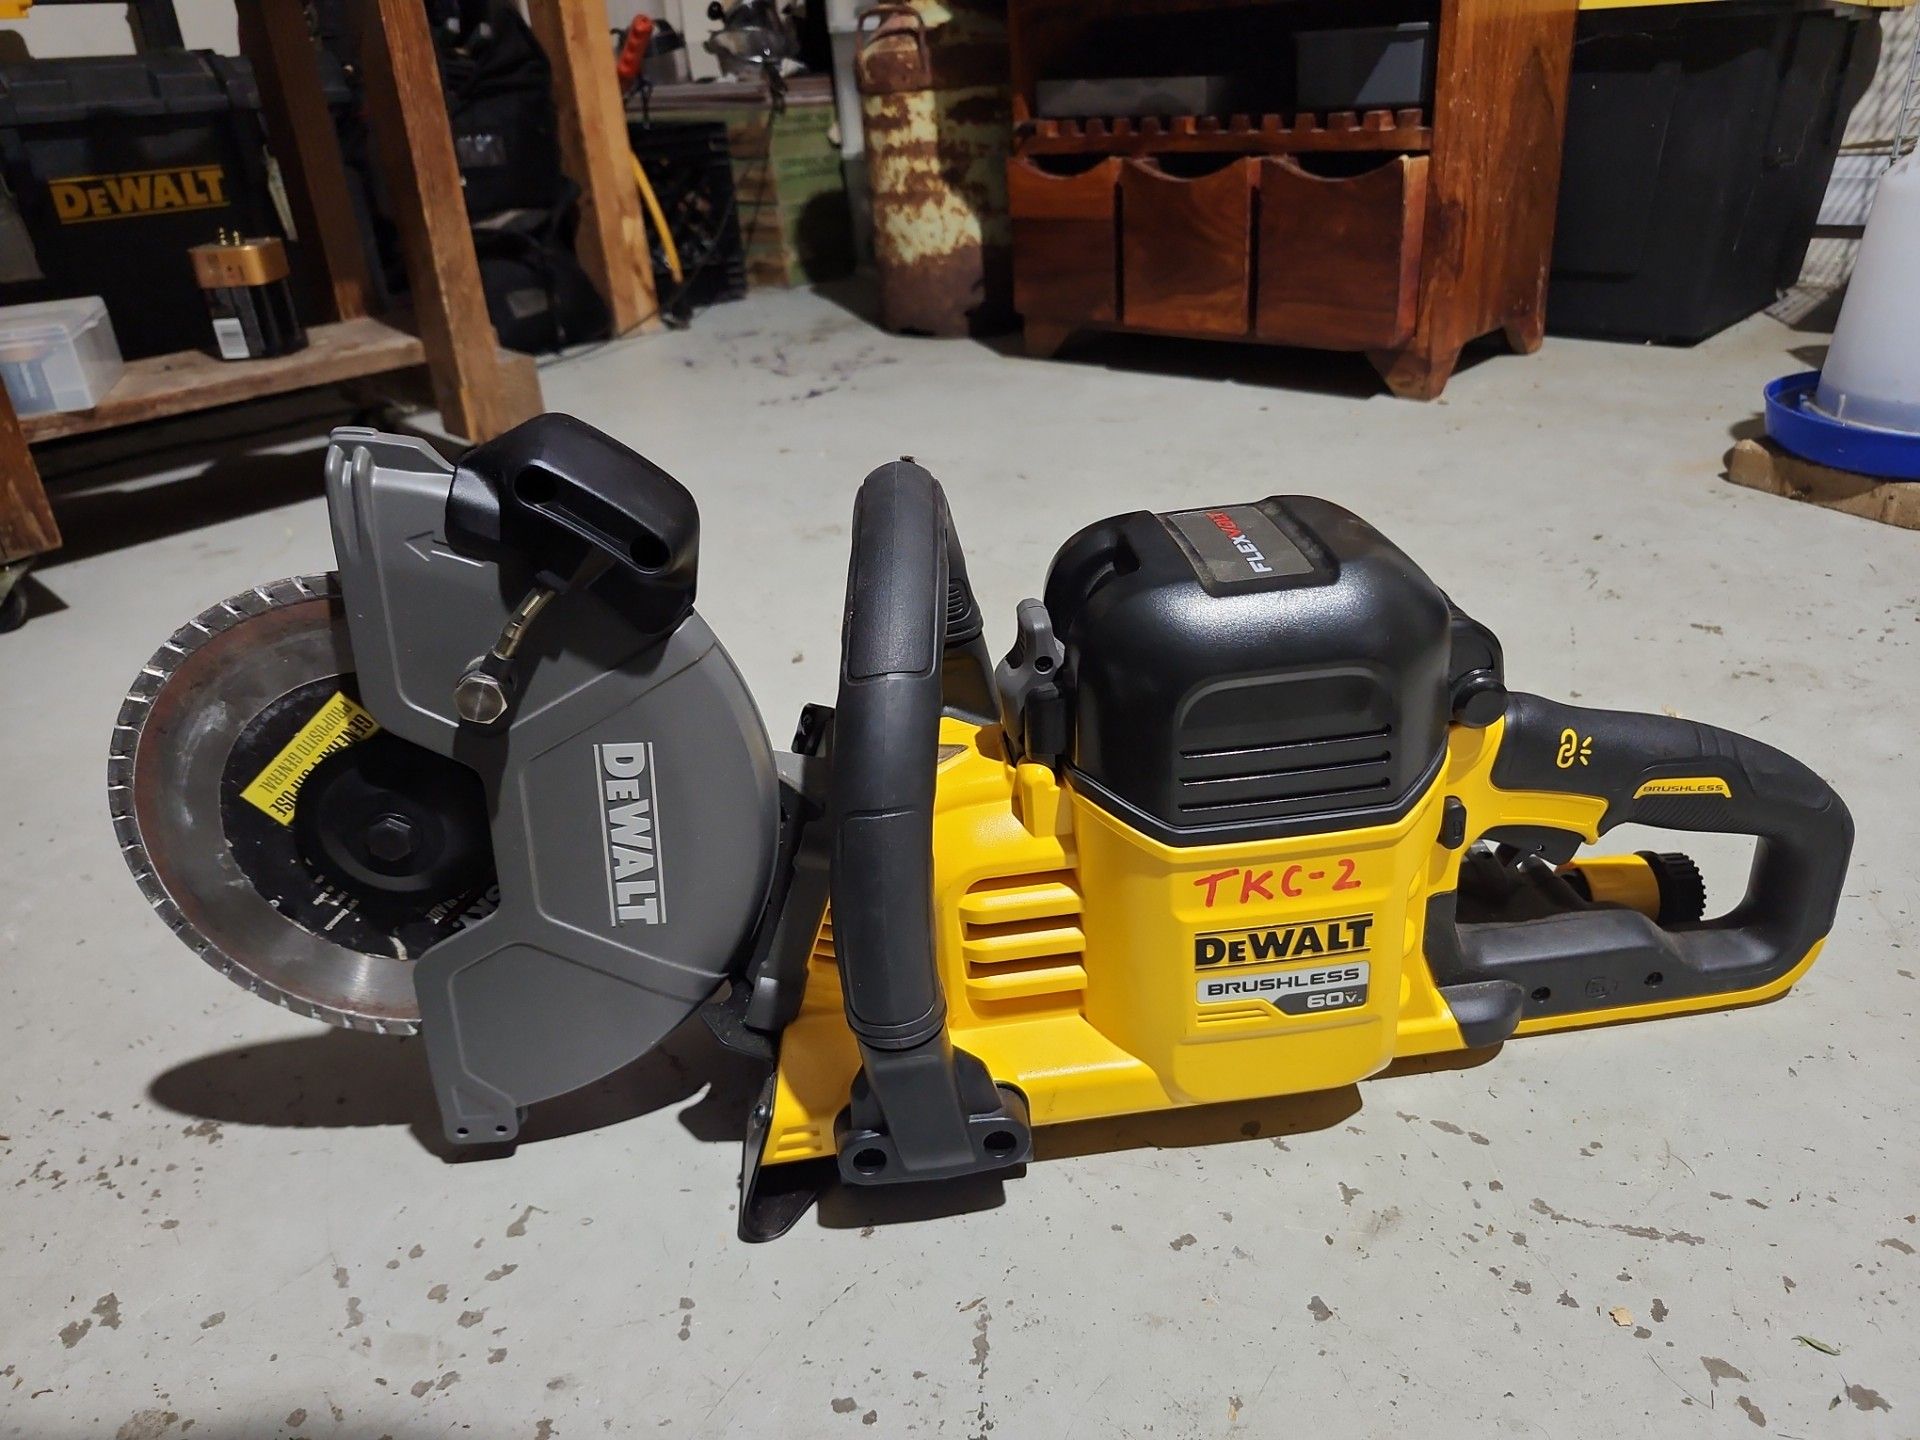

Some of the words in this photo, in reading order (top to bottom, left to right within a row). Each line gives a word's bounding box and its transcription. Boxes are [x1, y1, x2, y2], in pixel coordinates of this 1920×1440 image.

[259, 752, 304, 794] GENERAL
[1643, 784, 1723, 792] BRUSHLESS
[1194, 859, 1362, 908] TKC-2
[1207, 967, 1360, 996] BRUSHLESS
